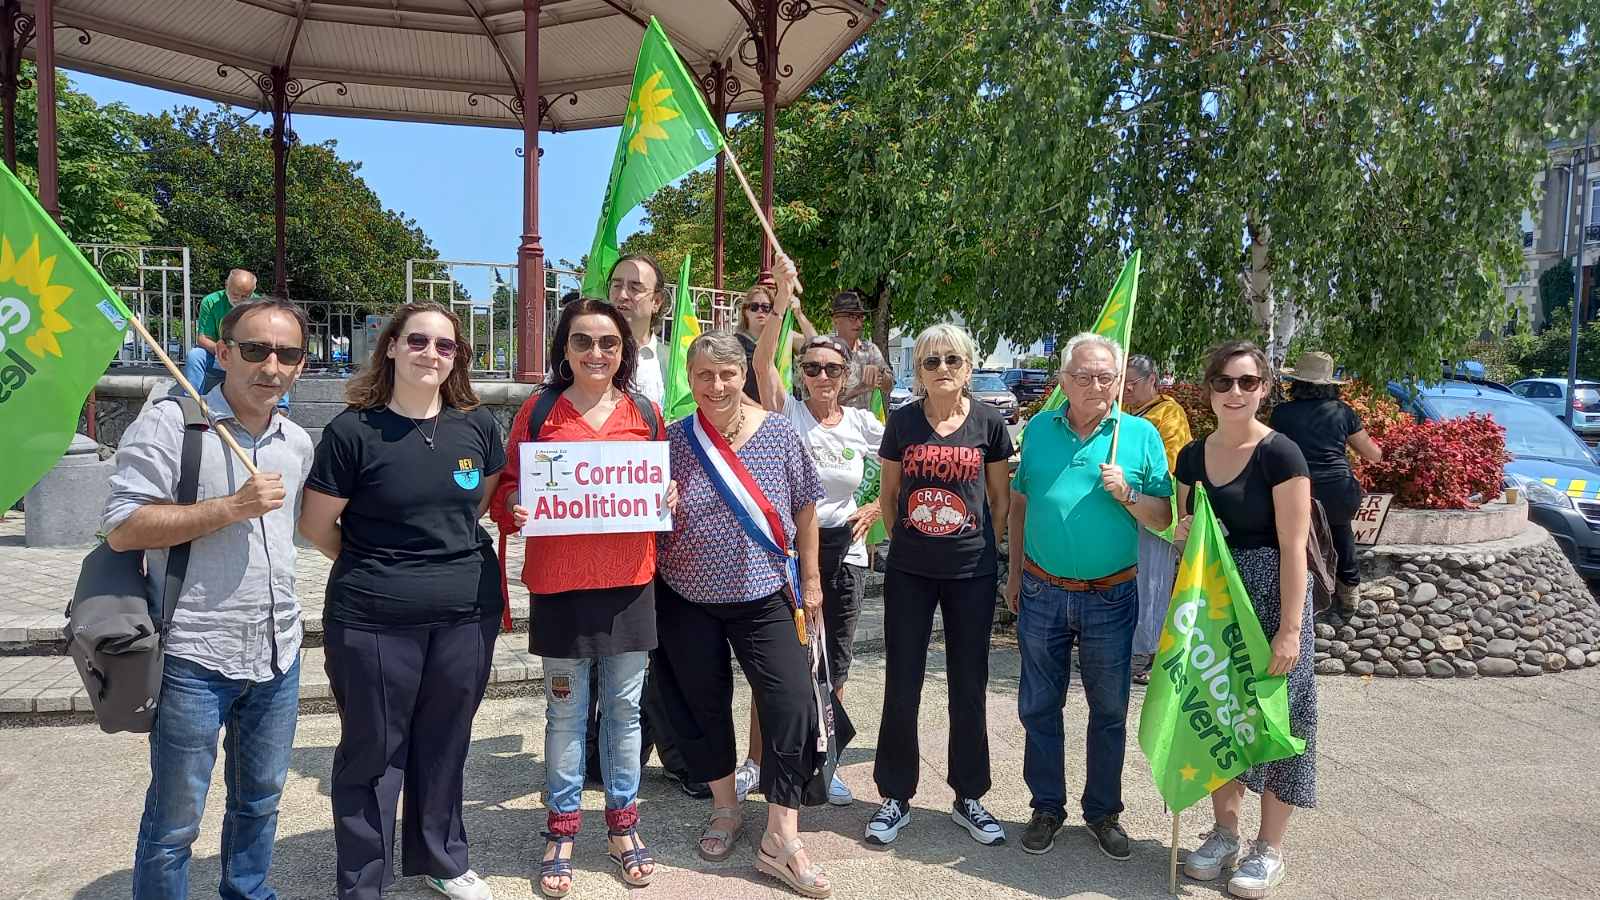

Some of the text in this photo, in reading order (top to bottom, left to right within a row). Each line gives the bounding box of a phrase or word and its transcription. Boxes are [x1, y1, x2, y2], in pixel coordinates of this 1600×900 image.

[904, 444, 982, 465] CORRIDA
[574, 460, 662, 486] Corrida
[534, 493, 661, 520] Abolition !
[917, 490, 952, 506] CRAC
[917, 521, 951, 533] EUROPE
[1161, 648, 1188, 694] les
